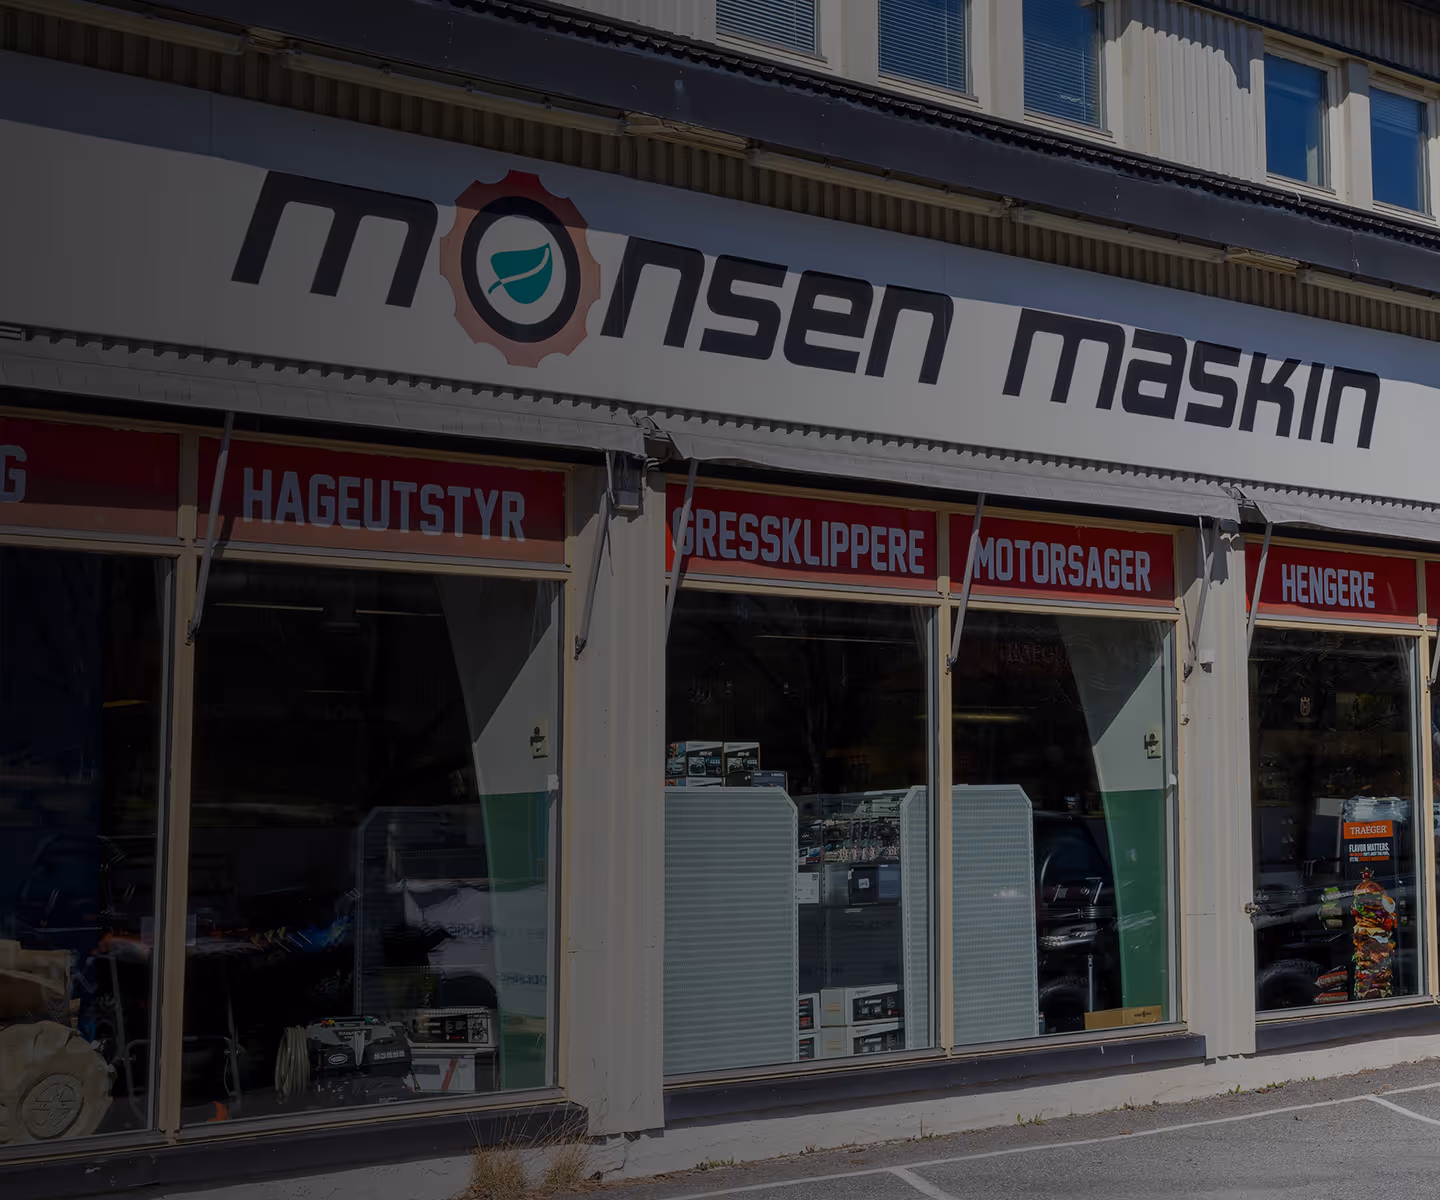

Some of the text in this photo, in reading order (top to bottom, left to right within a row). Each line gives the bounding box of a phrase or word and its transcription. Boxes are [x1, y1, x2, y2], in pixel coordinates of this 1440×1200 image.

[242, 466, 526, 543] HAGEUTSTYR
[672, 506, 925, 574] GRESSKLIPPERE
[973, 535, 1151, 592] MOTORSAGER
[1281, 563, 1376, 609] HENGERE
[1350, 825, 1388, 835] TRAEGER
